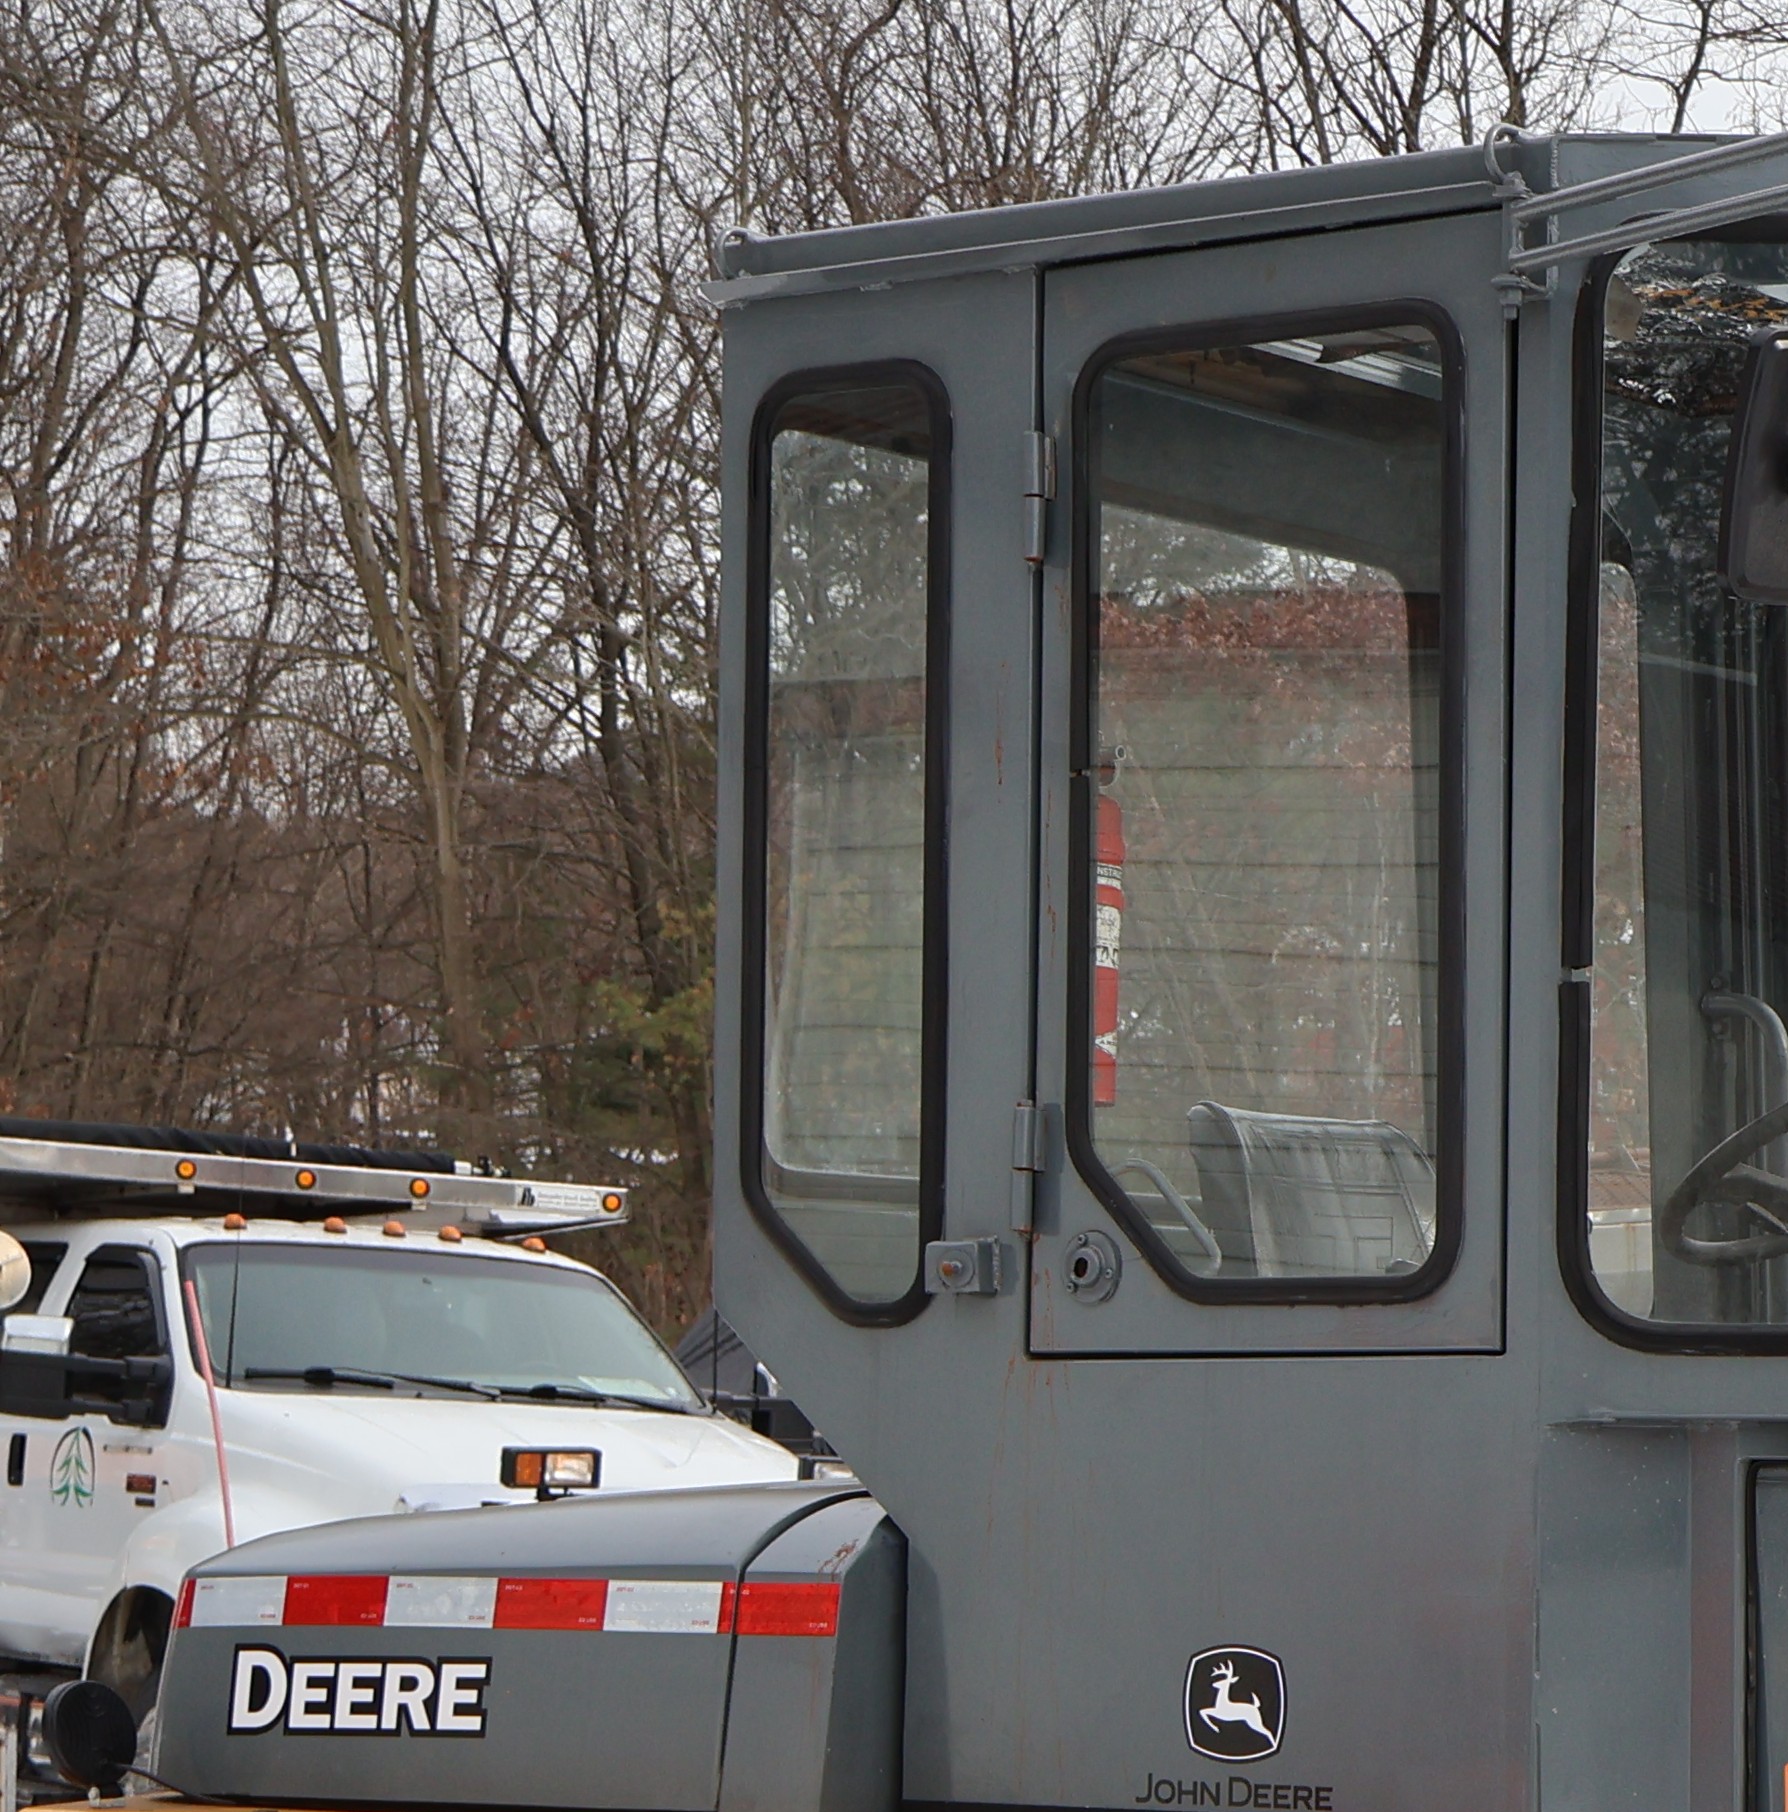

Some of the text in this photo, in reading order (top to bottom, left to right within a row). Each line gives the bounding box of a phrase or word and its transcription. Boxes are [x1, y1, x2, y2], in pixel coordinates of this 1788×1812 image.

[230, 1648, 491, 1733] DEERE
[1135, 1772, 1334, 1812] JOHN DEERE
